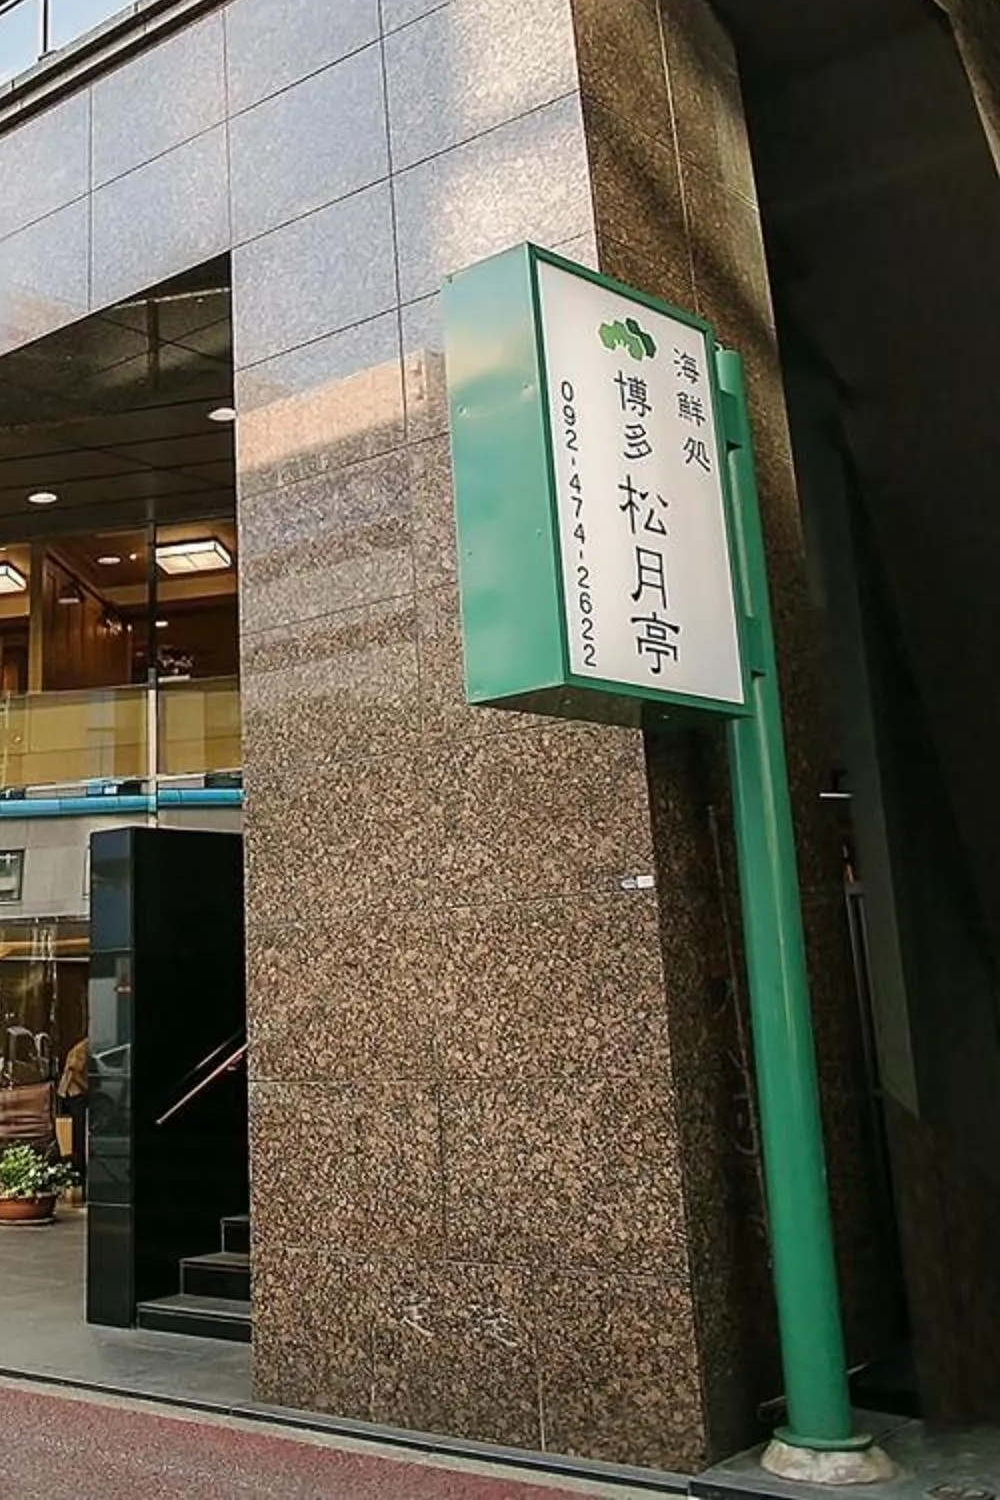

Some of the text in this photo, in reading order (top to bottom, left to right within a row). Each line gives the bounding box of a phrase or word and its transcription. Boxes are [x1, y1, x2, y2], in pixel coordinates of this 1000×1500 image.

[673, 348, 711, 472] 海鮮処
[560, 381, 597, 668] 092-474-2622
